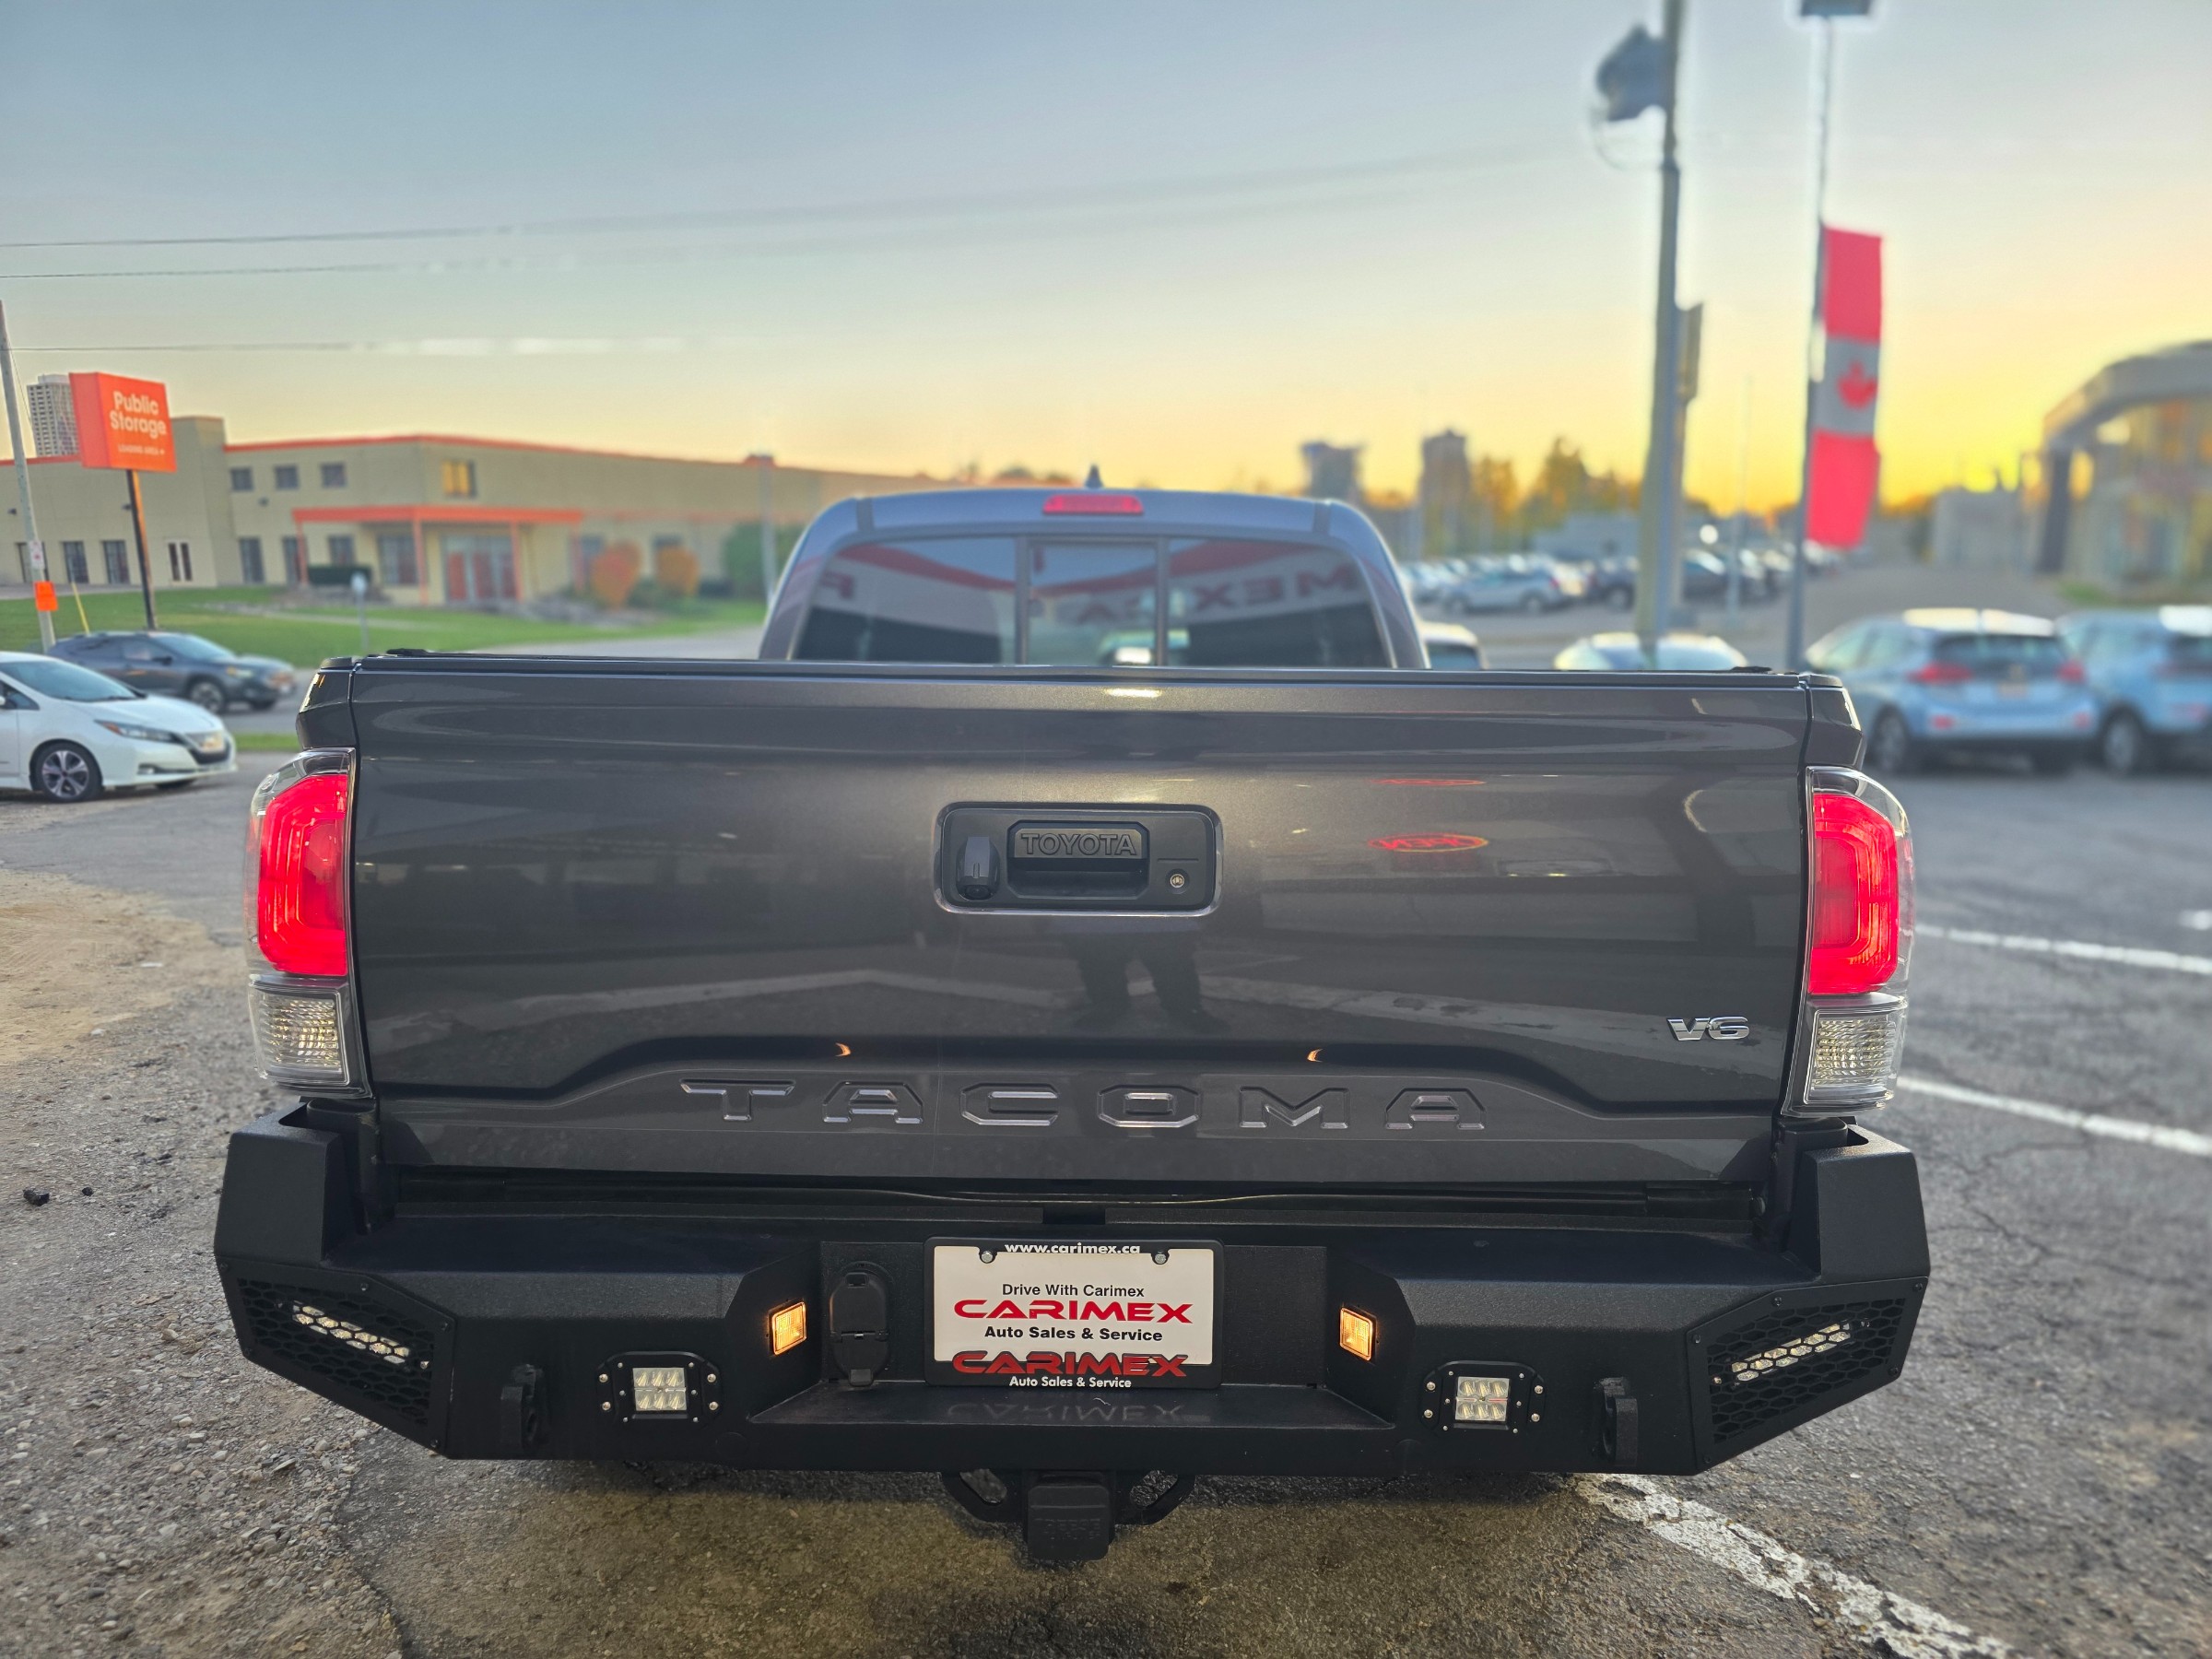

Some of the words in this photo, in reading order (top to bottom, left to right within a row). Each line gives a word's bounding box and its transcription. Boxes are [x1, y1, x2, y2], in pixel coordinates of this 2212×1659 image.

[112, 391, 159, 416] Public
[110, 410, 167, 440] Storage
[1020, 832, 1137, 856] TOYOTA
[1666, 1016, 1750, 1041] V6
[679, 1078, 1487, 1130] TACOMA
[1004, 1241, 1141, 1254] www.carimex.ca
[1002, 1283, 1041, 1296] Drive
[1045, 1284, 1078, 1296] With
[1083, 1284, 1145, 1298] Carimex
[953, 1299, 1194, 1324] CARIMEX
[984, 1325, 1024, 1338] Auto
[1029, 1326, 1076, 1339] Sales
[1081, 1327, 1094, 1340] &
[1099, 1328, 1163, 1342] Service
[952, 1350, 1188, 1377] CARIMEX
[1009, 1375, 1039, 1387] Auto
[1041, 1376, 1073, 1387] Sales
[1076, 1376, 1086, 1388] &
[1088, 1376, 1133, 1388] Service
